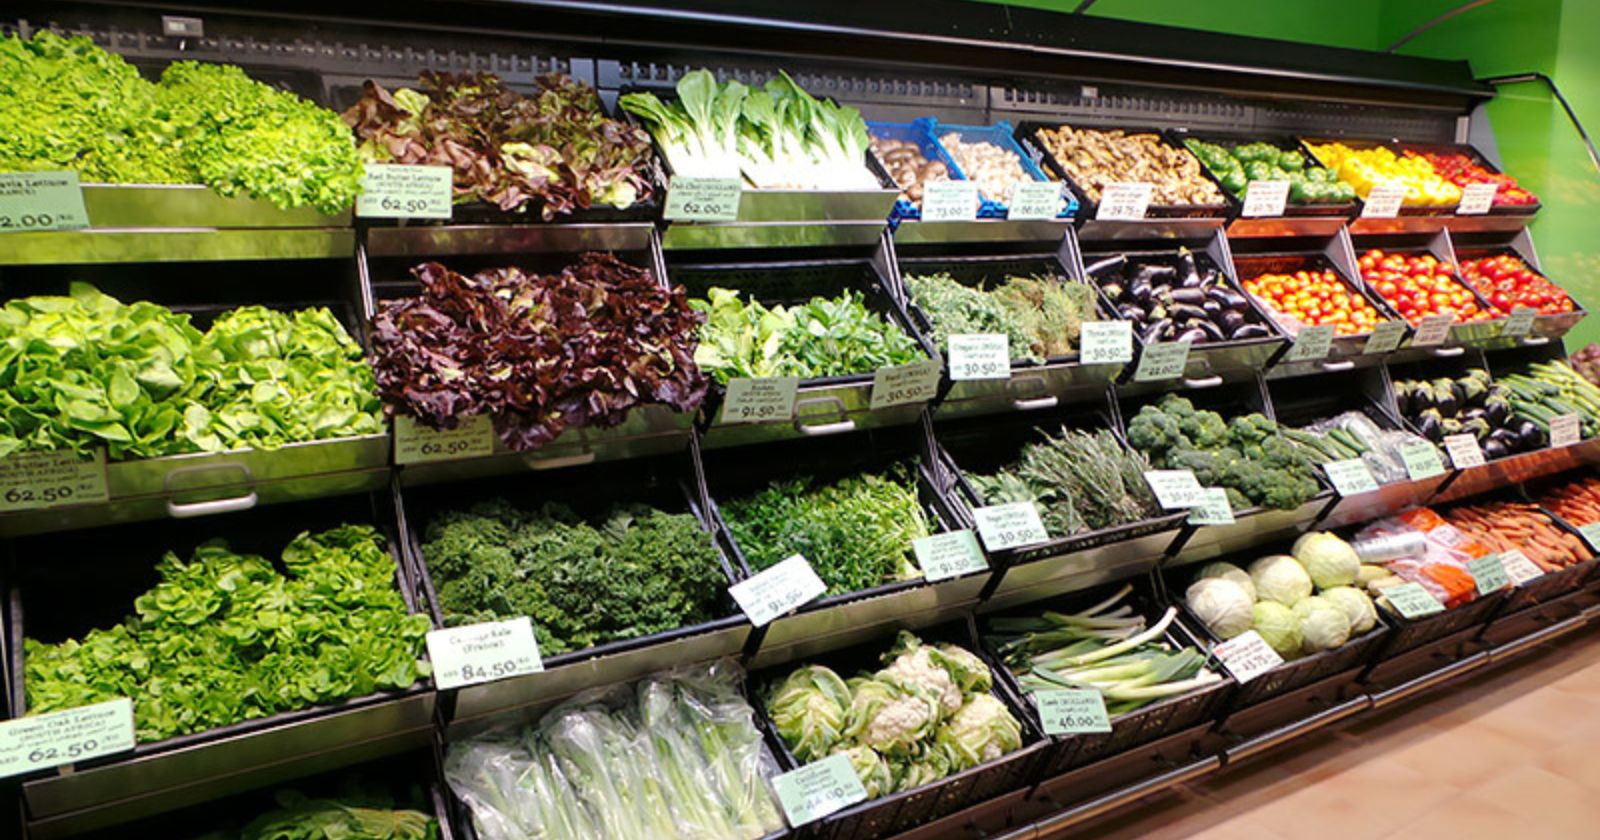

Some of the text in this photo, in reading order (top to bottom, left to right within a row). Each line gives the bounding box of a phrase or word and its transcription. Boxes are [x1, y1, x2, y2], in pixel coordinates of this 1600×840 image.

[381, 196, 428, 213] 62.50
[684, 201, 721, 214] 62.00
[1092, 347, 1120, 360] 30.50
[963, 362, 997, 376] 30.50
[887, 385, 922, 402] 30.50
[742, 405, 775, 418] 91.50
[420, 439, 468, 455] 62.50
[5, 486, 73, 503] 62.50
[998, 529, 1033, 545] 30.50
[939, 557, 970, 573] 91.50
[767, 588, 803, 613] 91.50
[461, 660, 517, 681] 84.50
[8, 724, 44, 736] Green
[47, 718, 70, 728] Oak
[73, 710, 115, 722] Lettuce
[1059, 713, 1095, 729] 46.00
[28, 739, 98, 763] 62.50
